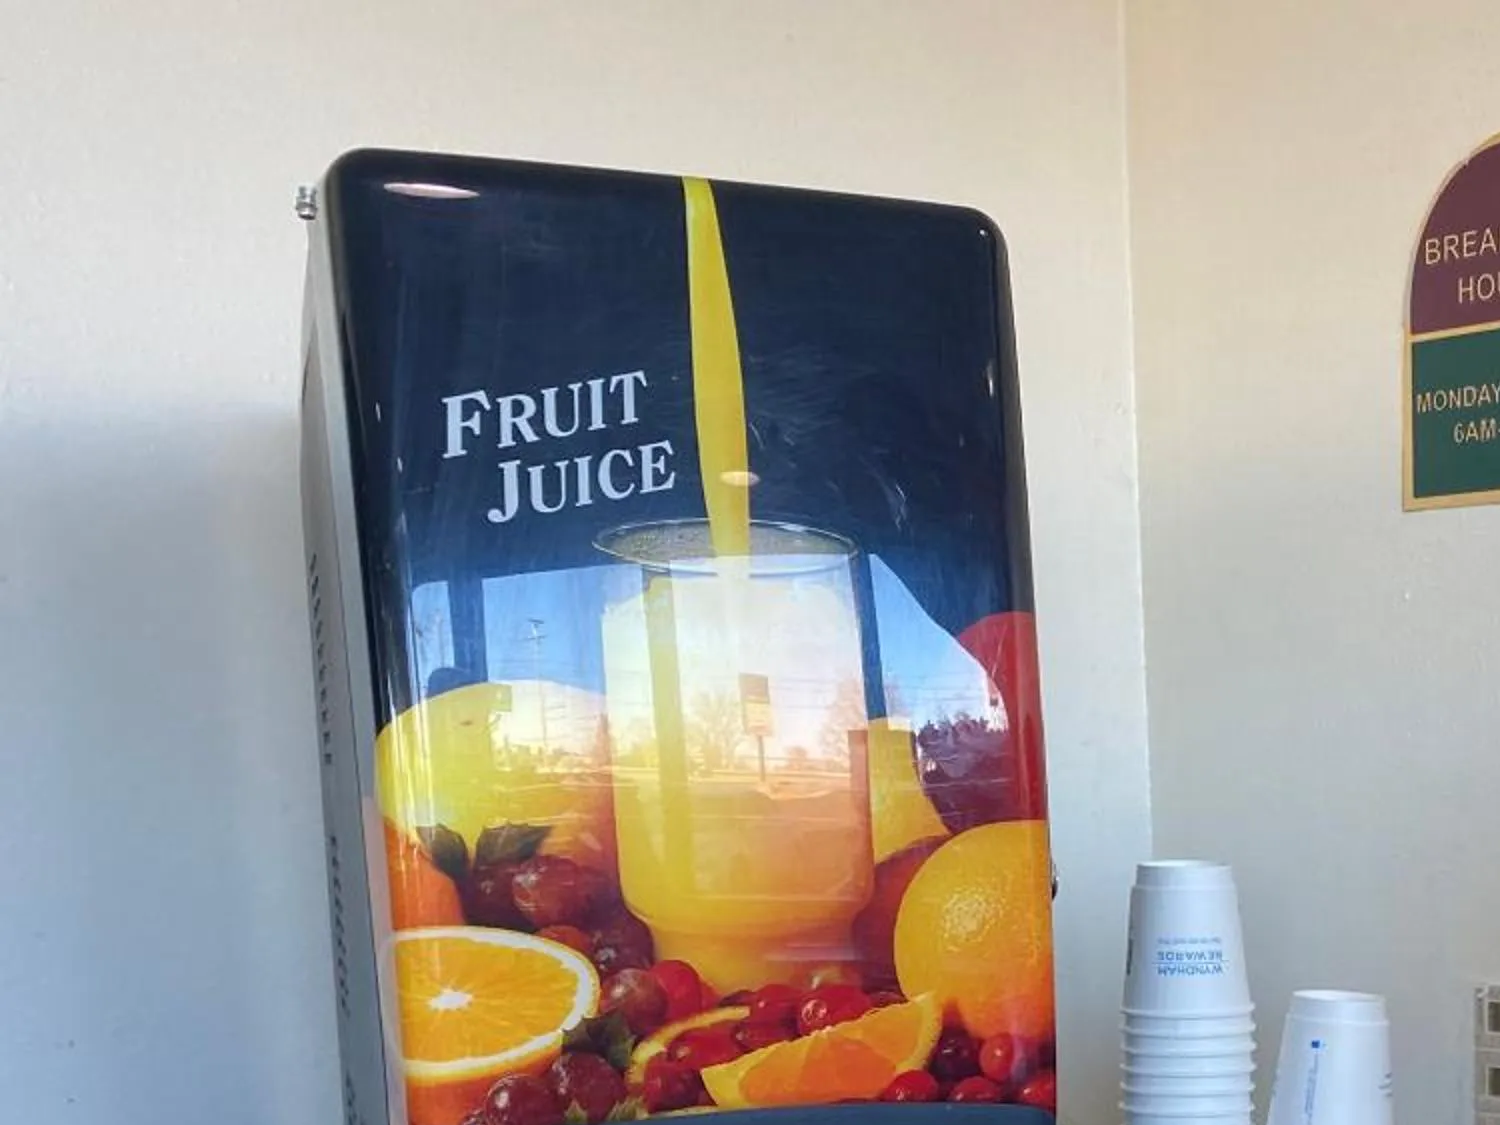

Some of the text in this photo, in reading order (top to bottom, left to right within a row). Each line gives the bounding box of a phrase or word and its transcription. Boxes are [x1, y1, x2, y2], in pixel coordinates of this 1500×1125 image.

[441, 370, 648, 459] FRUIT
[487, 439, 676, 523] JUICE
[1157, 965, 1224, 977] WYNDHAM
